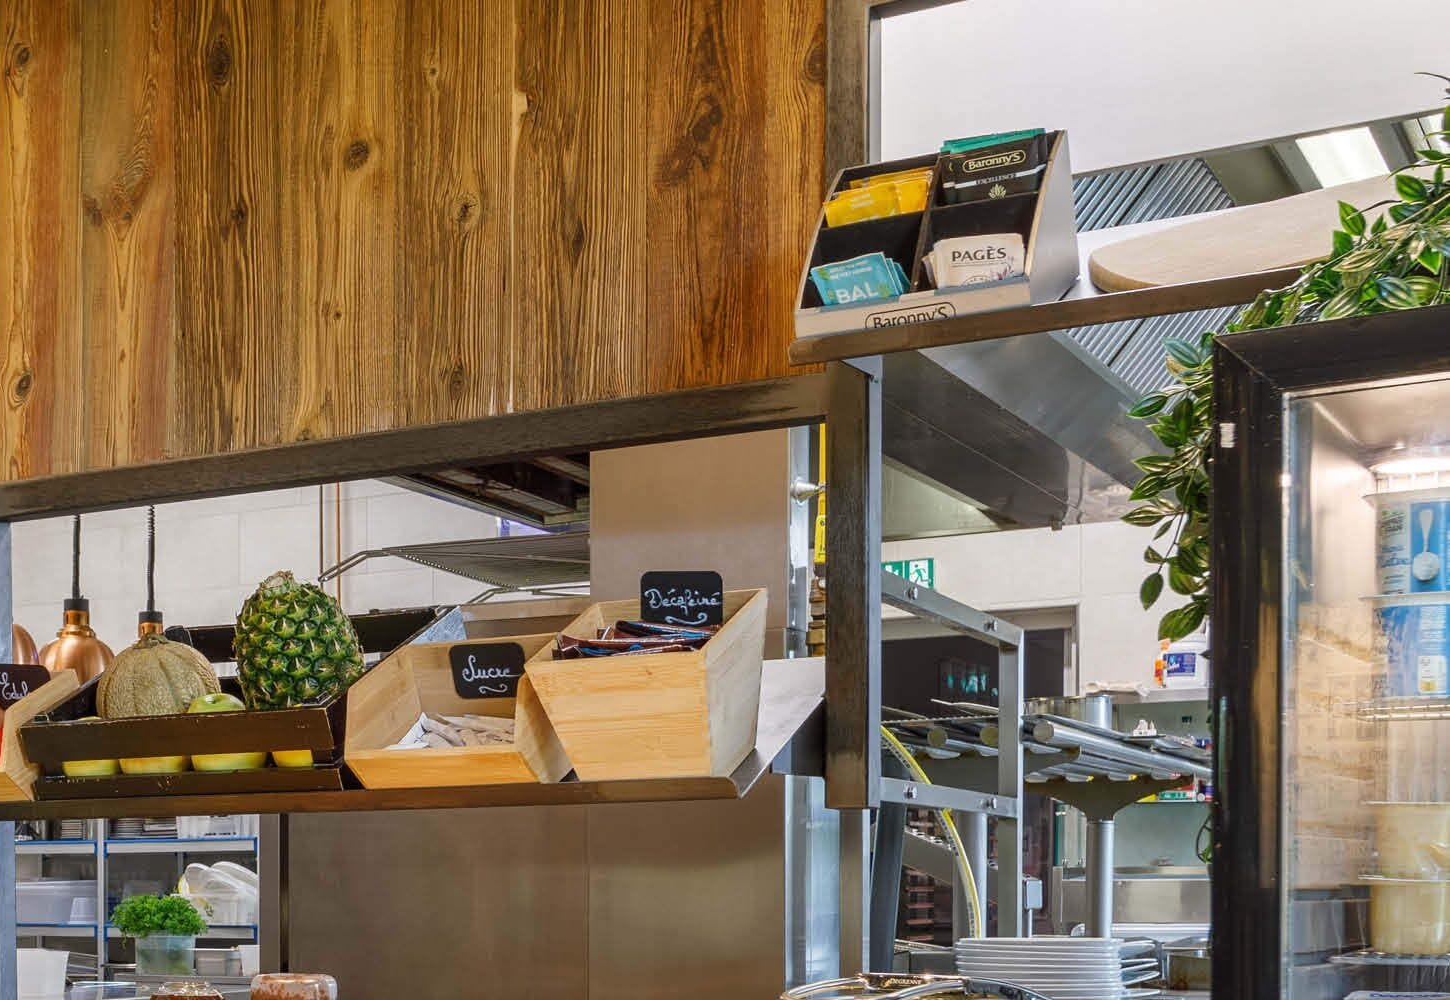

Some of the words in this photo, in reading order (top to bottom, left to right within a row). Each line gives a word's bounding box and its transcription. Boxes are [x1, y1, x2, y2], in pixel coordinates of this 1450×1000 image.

[968, 151, 1021, 170] Baronny'S
[951, 245, 1007, 262] PAGÈS
[461, 654, 520, 682] Sucre
